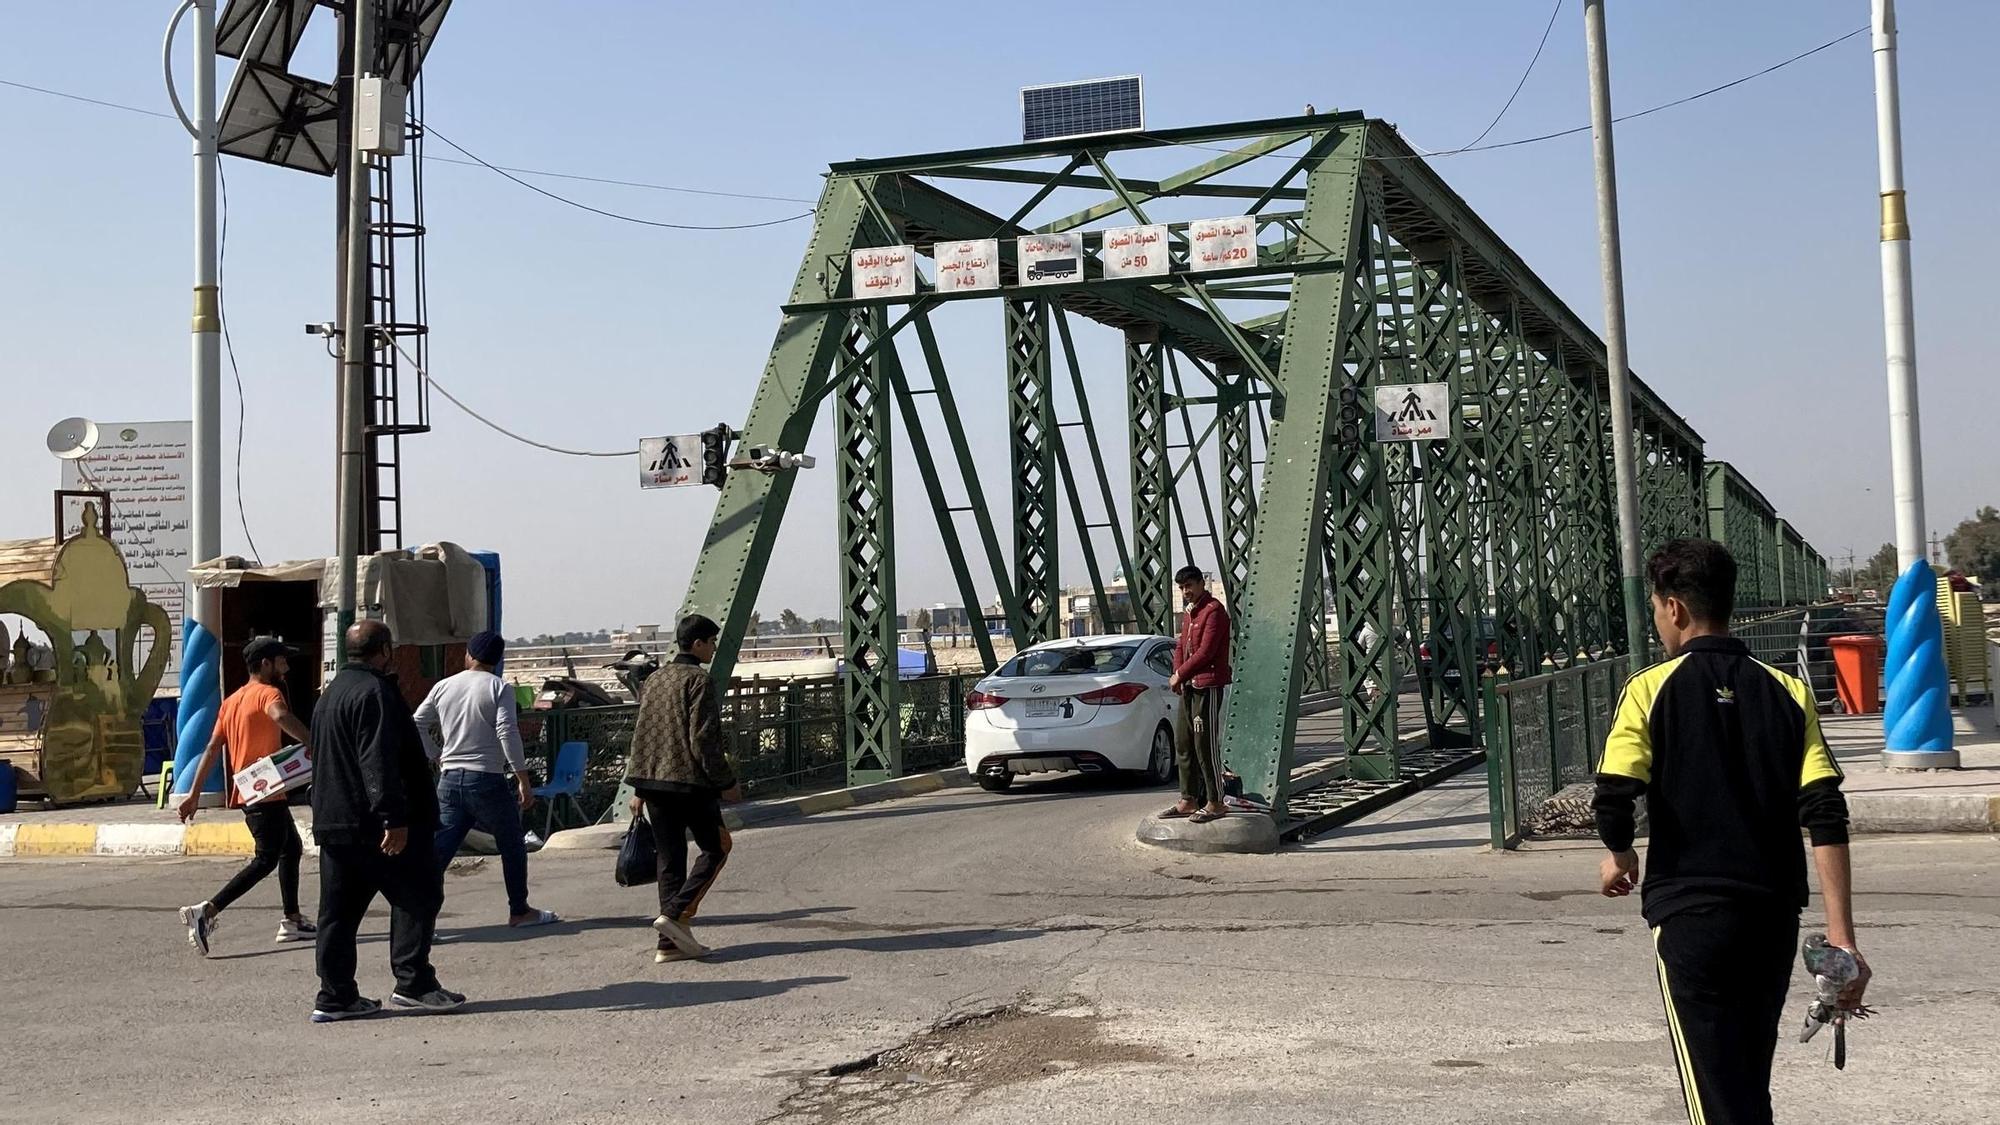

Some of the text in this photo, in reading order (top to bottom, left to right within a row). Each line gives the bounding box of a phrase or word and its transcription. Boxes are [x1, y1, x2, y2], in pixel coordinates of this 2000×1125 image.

[1221, 224, 1247, 238] السرعة
[1134, 231, 1159, 247] الحمولة
[857, 252, 905, 269] ممنوع الوقوف
[941, 258, 988, 272] ارتفاع الجسر
[1121, 255, 1148, 268] 50 طن
[865, 275, 892, 289] التوقف
[1415, 426, 1432, 436] ممر
[674, 474, 688, 484] ممر
[165, 548, 187, 558] شركة
